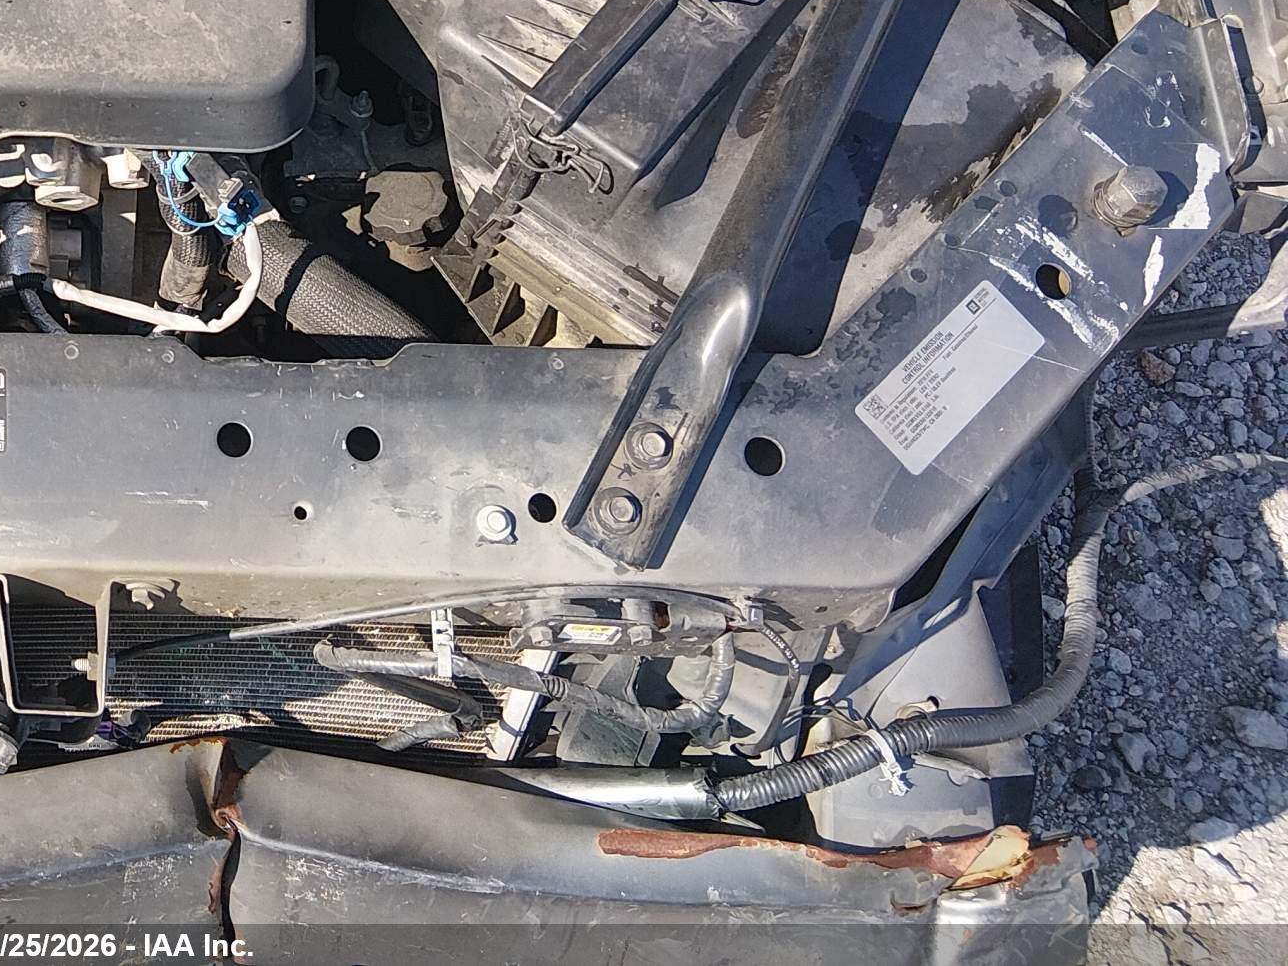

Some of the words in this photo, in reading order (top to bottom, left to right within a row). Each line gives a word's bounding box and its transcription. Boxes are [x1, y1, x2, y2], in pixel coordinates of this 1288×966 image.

[900, 361, 924, 385] CONTROL
[921, 330, 954, 364] INFORMATION
[901, 351, 923, 373] VEHICLE
[919, 330, 944, 354] EMISSION
